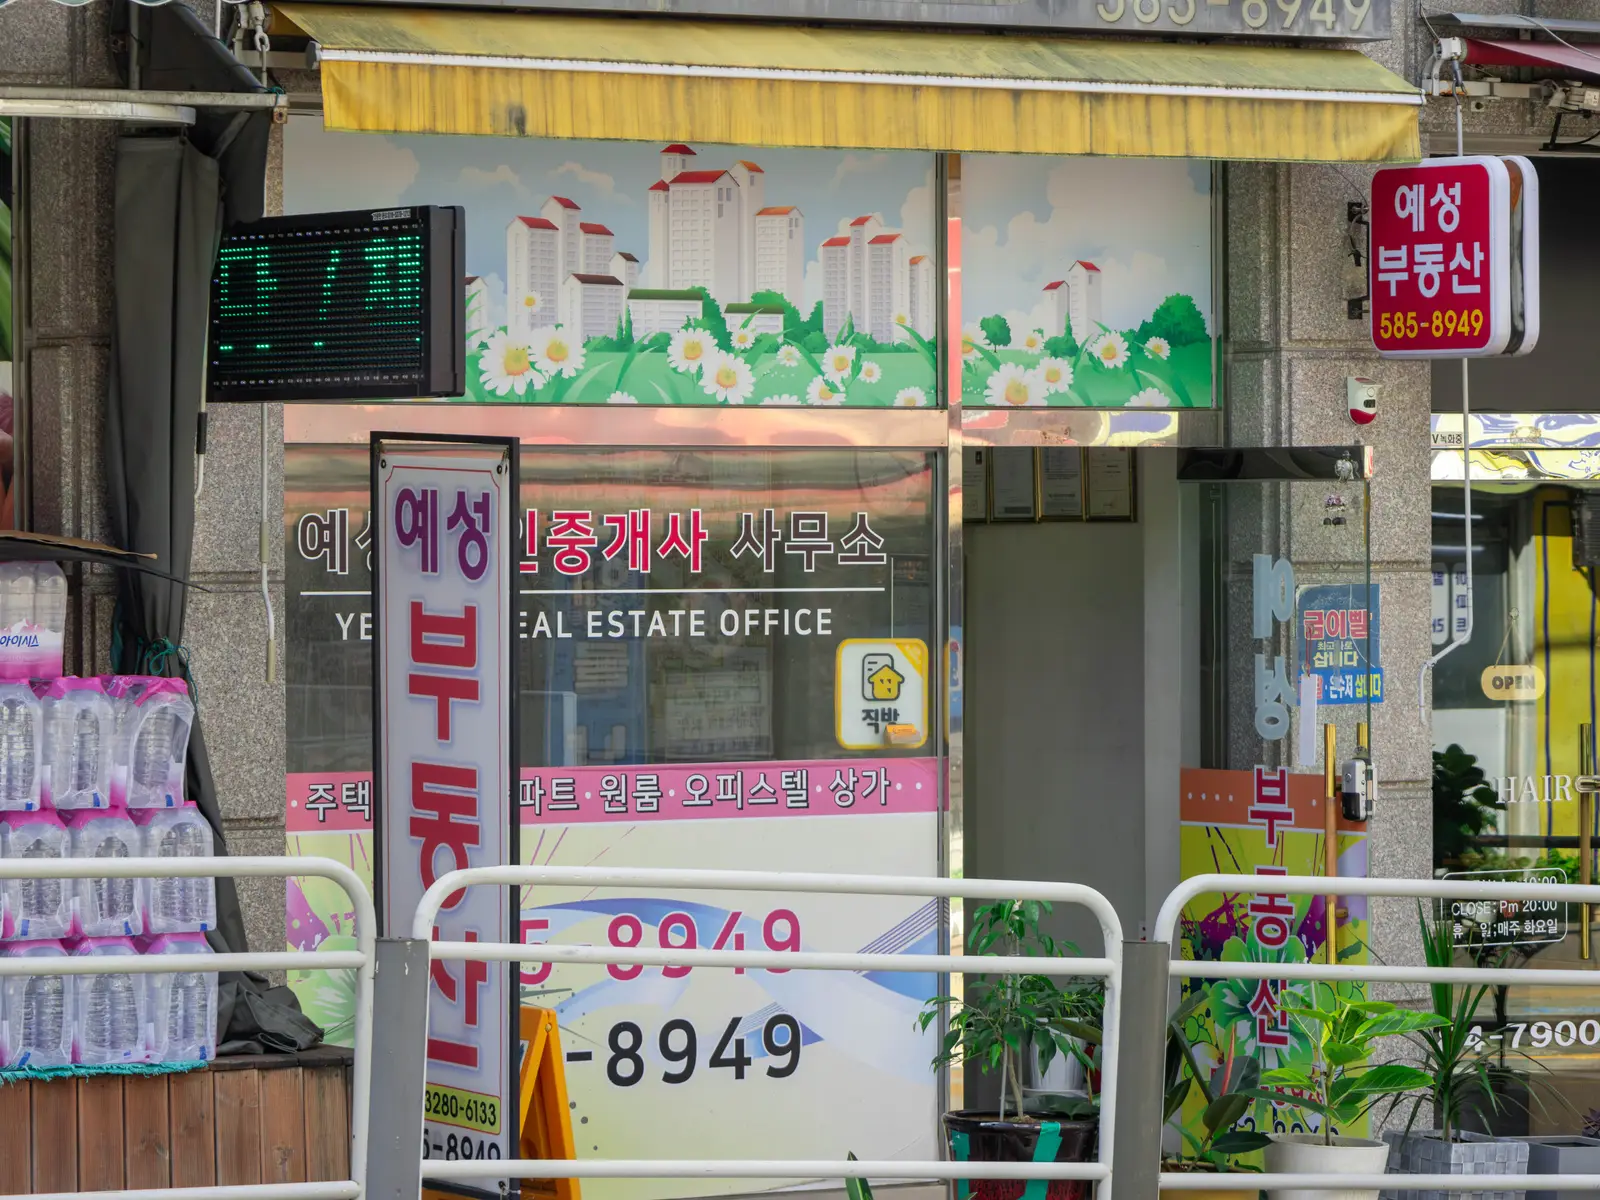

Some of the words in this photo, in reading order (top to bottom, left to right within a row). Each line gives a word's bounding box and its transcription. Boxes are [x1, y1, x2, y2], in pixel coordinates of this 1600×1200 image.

[1395, 182, 1461, 233] 예성
[1378, 241, 1485, 298] 부동산
[1380, 309, 1484, 339] 585-8949
[298, 508, 372, 575] 예
[730, 508, 887, 572] 사무소
[395, 487, 491, 581] 예성
[587, 610, 705, 638] ESTATE
[720, 608, 832, 636] OFFICE
[1491, 675, 1536, 690] OPEN
[305, 781, 371, 822] 주택
[599, 773, 663, 813] 원룸
[682, 769, 811, 810] 오피스텔
[828, 767, 891, 807] 상가
[1494, 774, 1573, 804] HAIR
[1248, 764, 1296, 1050] 부동산
[1451, 900, 1497, 916] CLOSE:
[1500, 900, 1519, 913] Pm
[1523, 899, 1557, 912] 20:00
[1523, 918, 1557, 935] 화요일
[425, 1090, 496, 1126] 3280-6133
